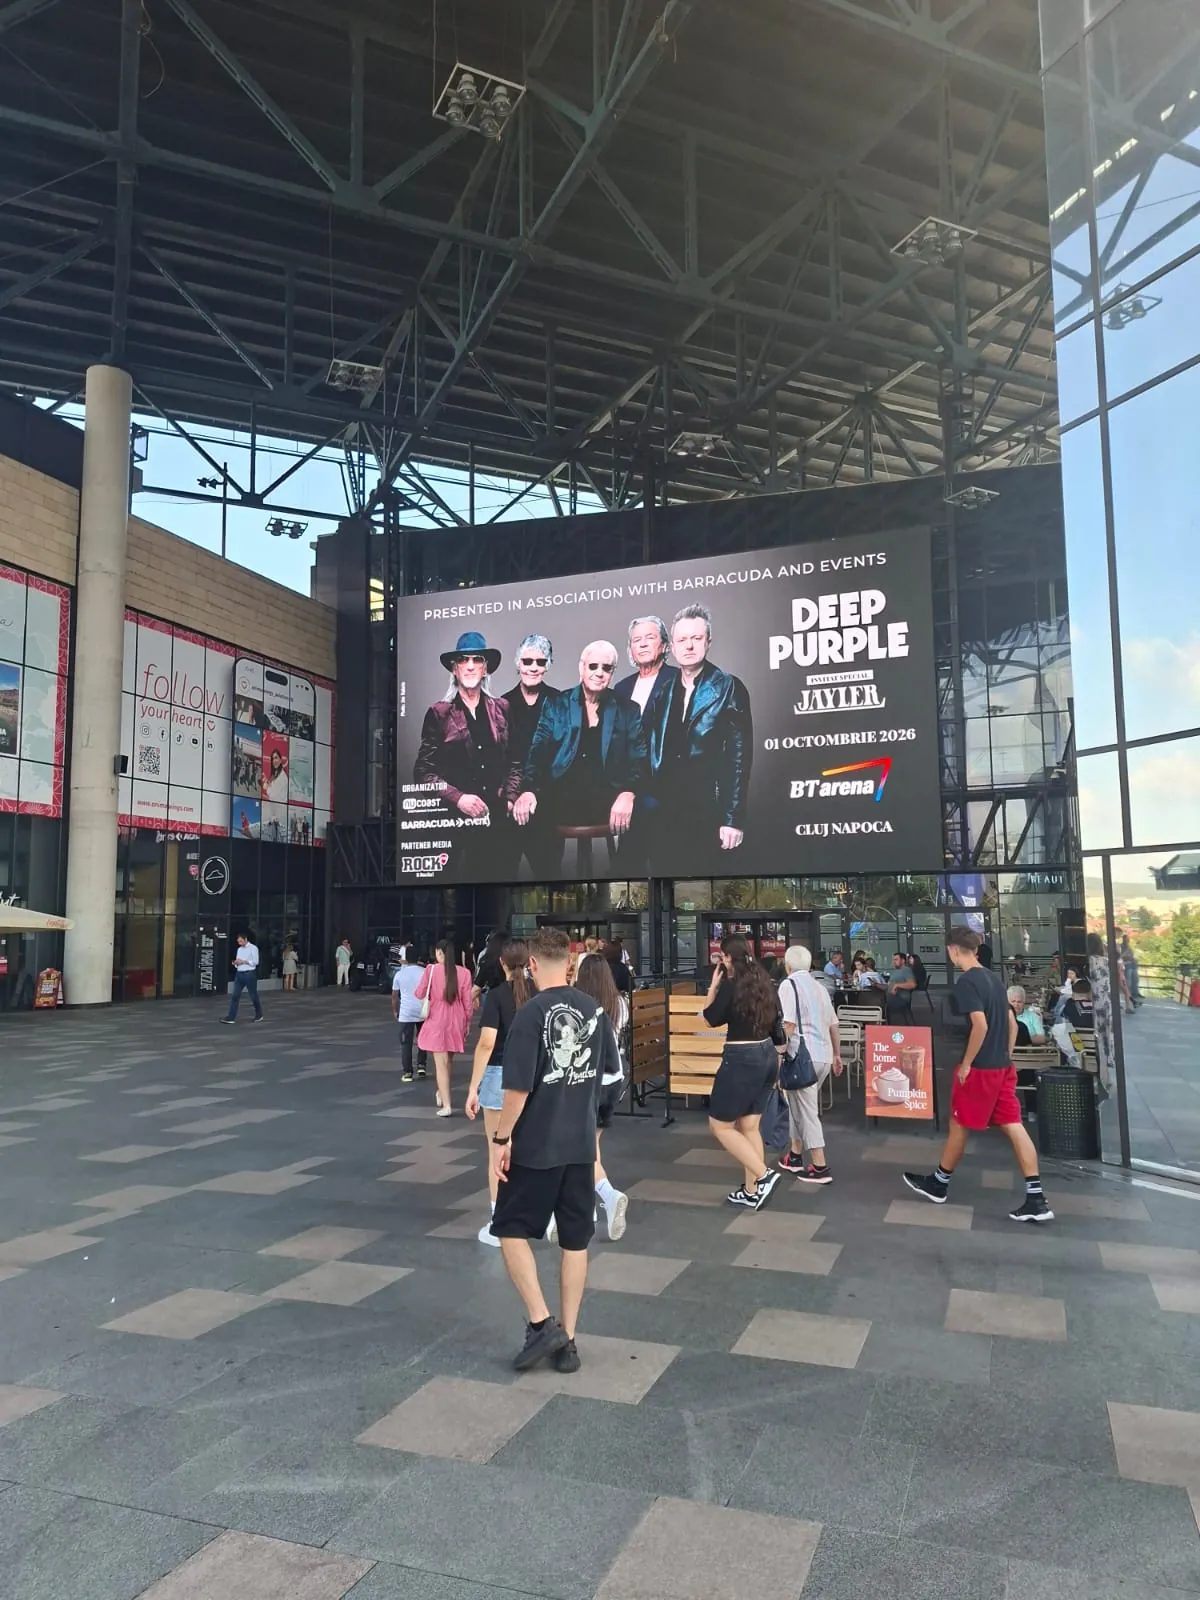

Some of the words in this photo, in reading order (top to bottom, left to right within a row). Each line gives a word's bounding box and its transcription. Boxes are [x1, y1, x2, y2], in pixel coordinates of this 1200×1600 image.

[424, 602, 503, 620] PRESENTED
[508, 599, 522, 612] IN
[526, 587, 623, 609] ASSOCIATION
[628, 581, 667, 596] WITH
[673, 567, 773, 591] BARRACUDA
[777, 562, 814, 577] AND
[820, 552, 887, 572] EVENTS
[792, 589, 887, 633] DEEP
[769, 621, 910, 670] PURPLE
[140, 663, 225, 715] follow
[798, 684, 881, 711] JAYLER
[140, 703, 170, 720] your
[171, 709, 204, 729] heart
[764, 738, 779, 750] 01
[782, 730, 877, 749] OCTOMBRIE
[880, 728, 916, 743] 2026
[402, 782, 448, 793] ORGANIZATOR
[401, 818, 456, 830] BARRACUDA
[795, 823, 829, 837] CLUJ
[832, 821, 893, 835] NAPOCA
[401, 841, 431, 850] PARTENER
[432, 840, 452, 849] MEDIA
[402, 855, 443, 872] ROCK
[873, 1042, 889, 1052] The
[873, 1052, 896, 1063] home
[873, 1063, 883, 1073] of
[888, 1087, 928, 1100] Pumpkin
[904, 1100, 928, 1111] Spice
